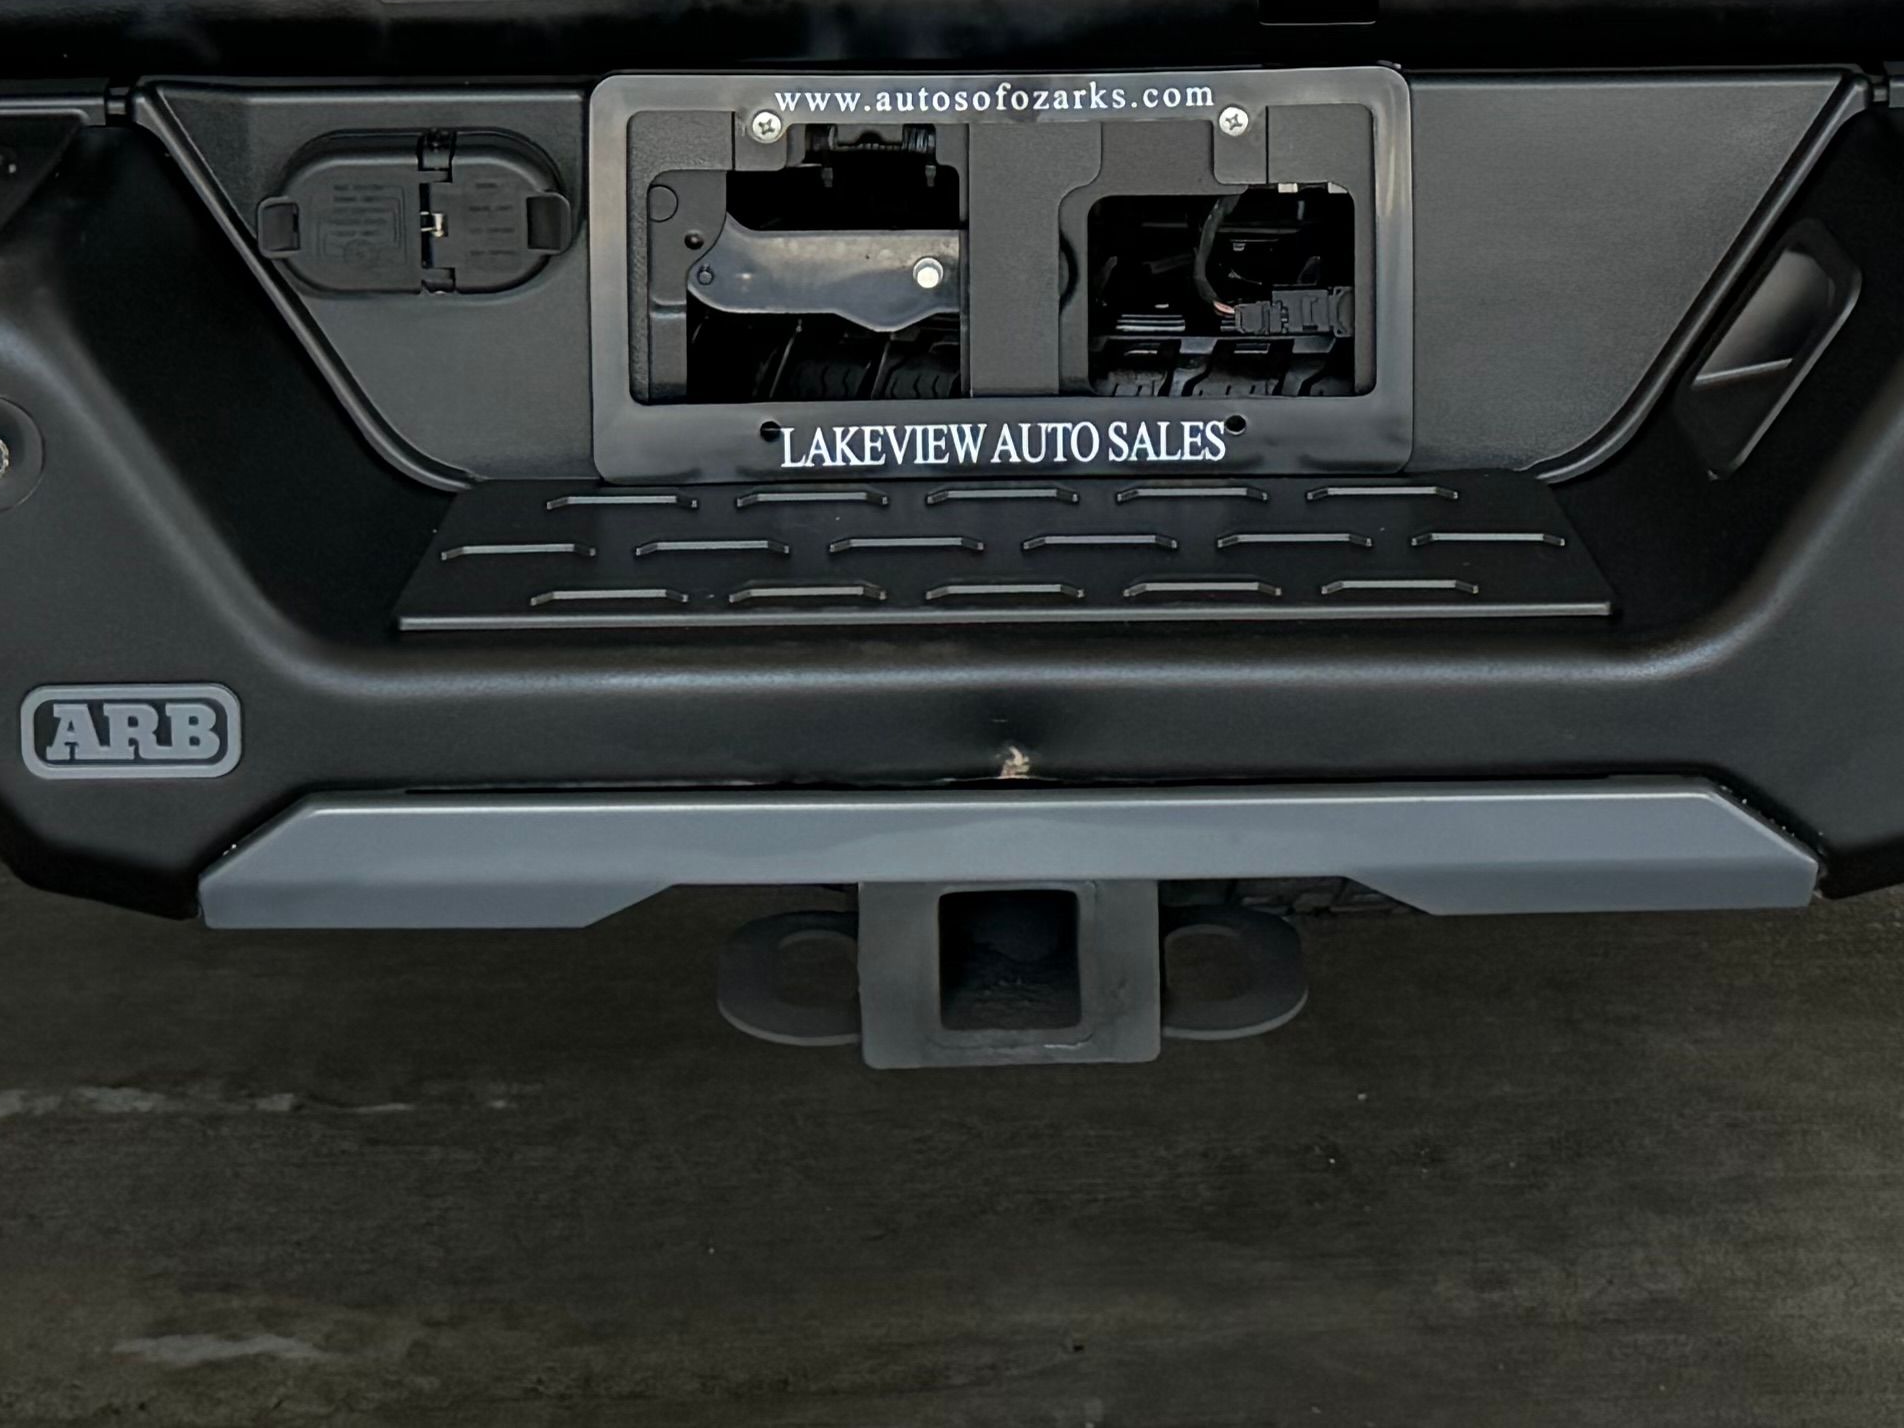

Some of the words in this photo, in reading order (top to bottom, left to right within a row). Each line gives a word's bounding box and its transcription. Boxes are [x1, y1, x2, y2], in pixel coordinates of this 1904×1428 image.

[773, 80, 1216, 113] www.autosofozarks.com
[780, 423, 988, 468] LAKEVIEW
[991, 421, 1100, 463] AUTO
[1107, 420, 1227, 462] SALES
[45, 702, 221, 760] ARB
